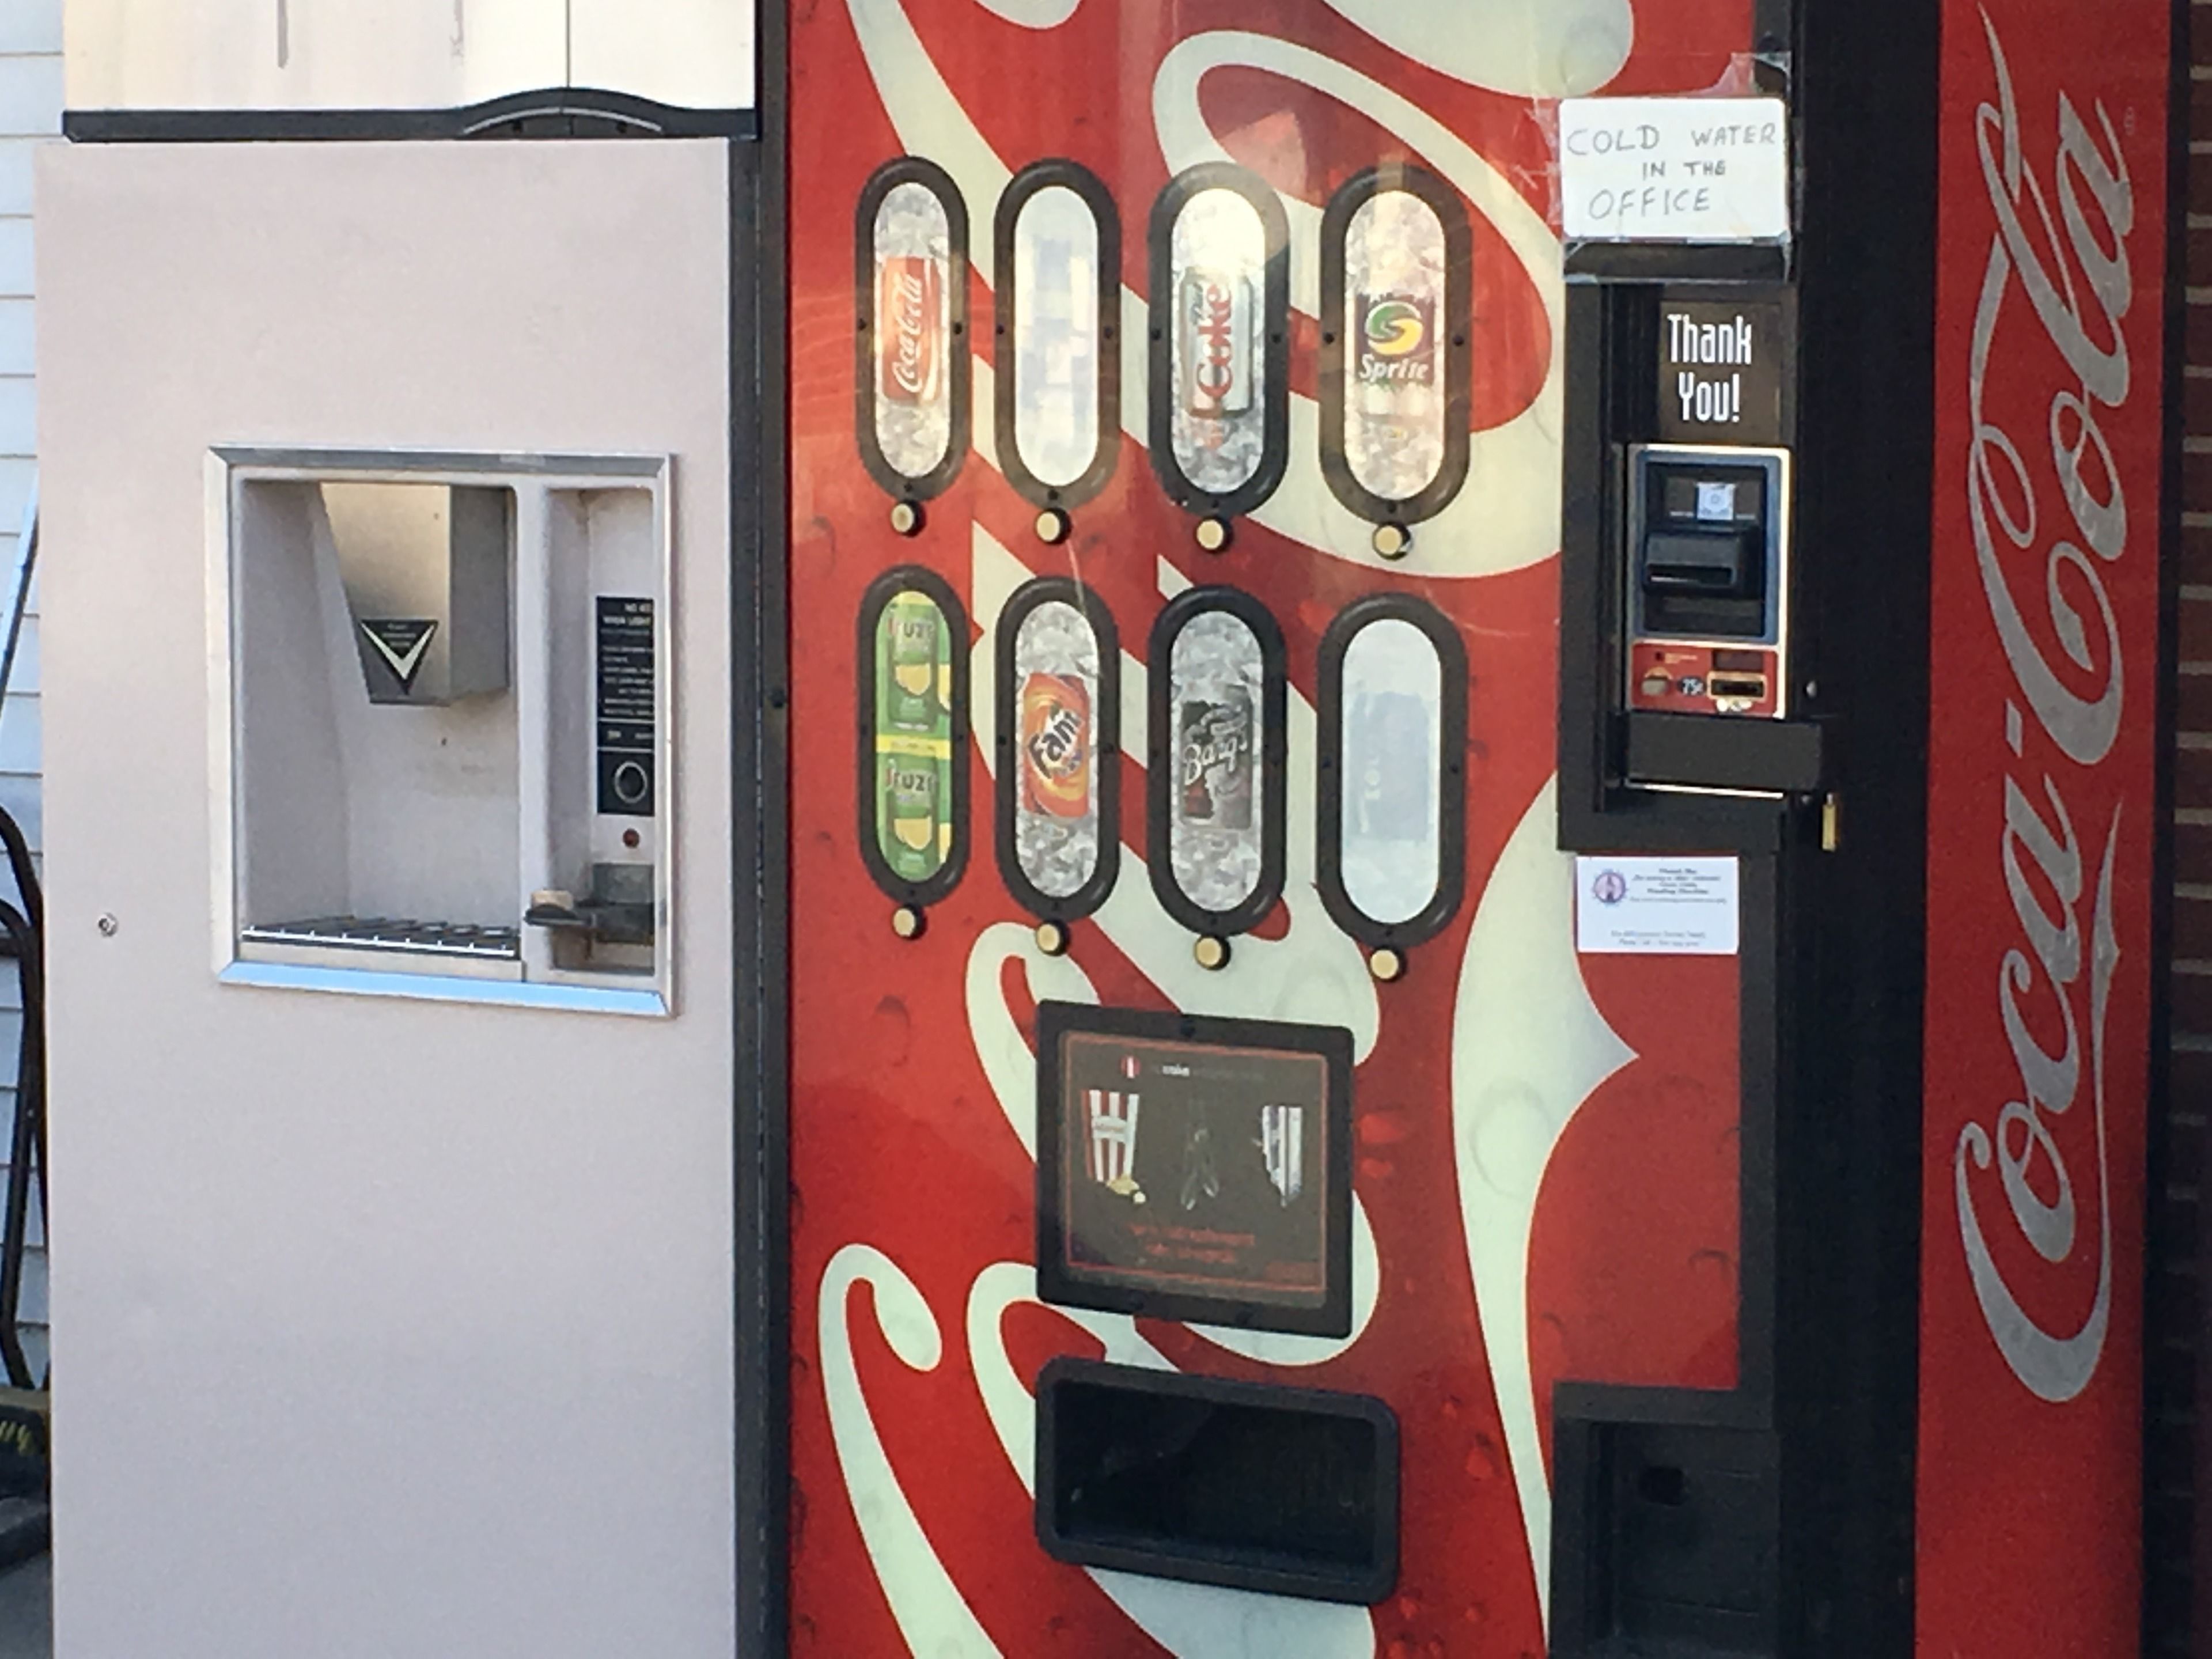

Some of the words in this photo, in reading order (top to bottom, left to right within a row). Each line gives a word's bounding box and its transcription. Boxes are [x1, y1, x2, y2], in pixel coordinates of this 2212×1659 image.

[1567, 124, 1660, 156] COLD
[1691, 122, 1776, 147] WATER
[1642, 162, 1665, 180] IN
[1683, 160, 1726, 176] THE
[1588, 187, 1711, 219] OFFICE
[1668, 314, 1752, 365] Thank
[1358, 353, 1429, 384] Sprite
[1678, 372, 1740, 422] You!
[1956, 2, 2133, 1402] Coca-Cola
